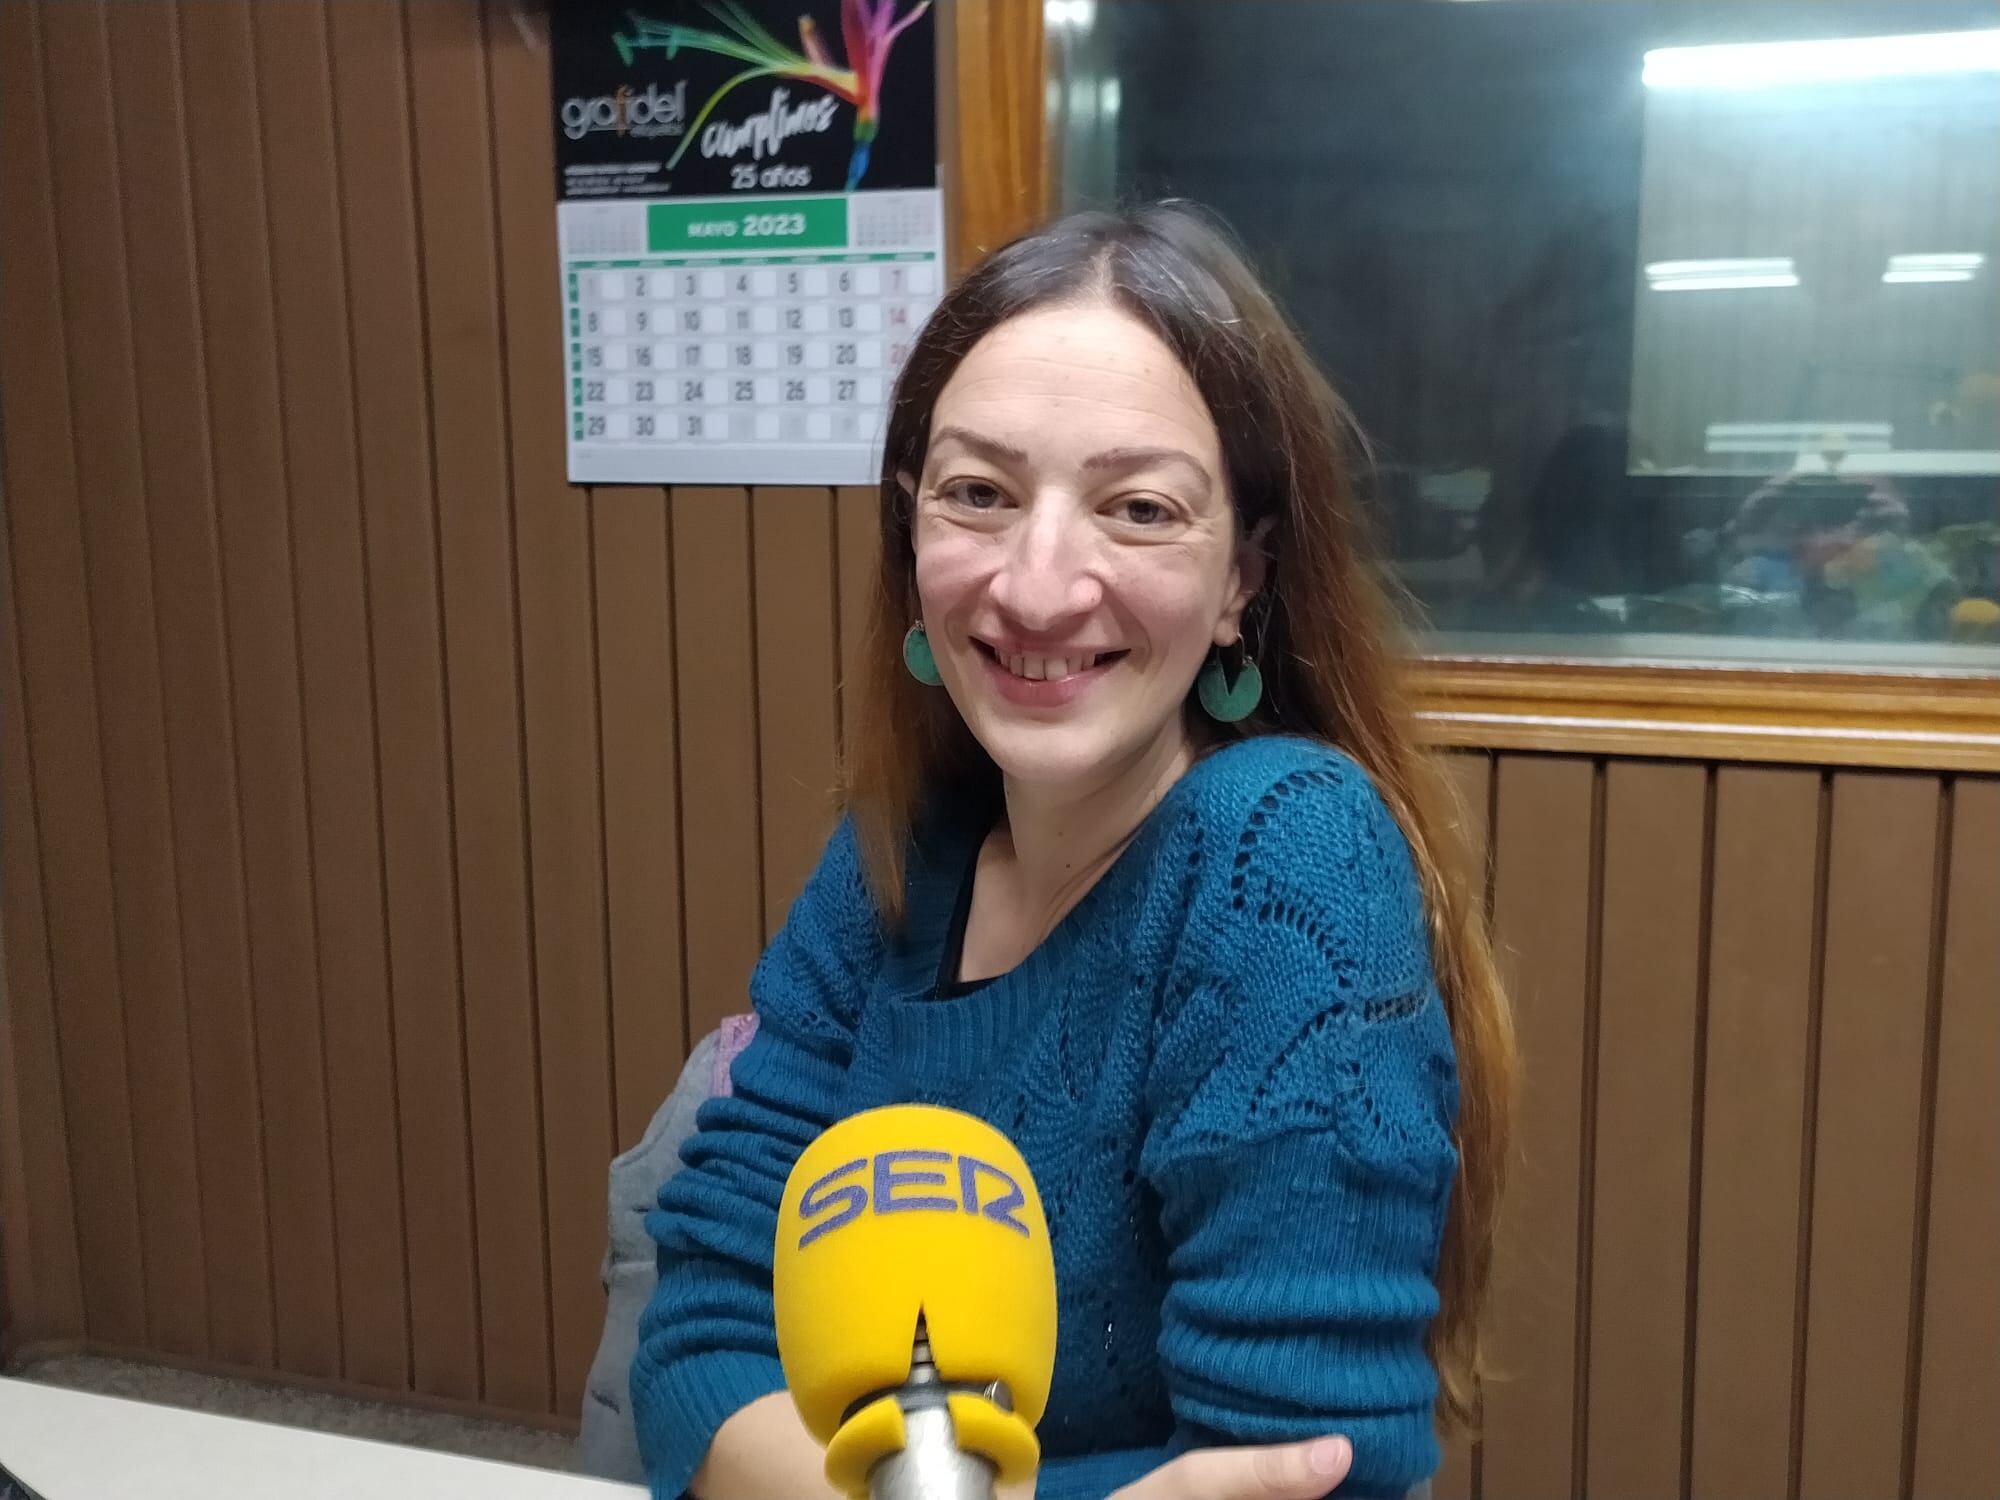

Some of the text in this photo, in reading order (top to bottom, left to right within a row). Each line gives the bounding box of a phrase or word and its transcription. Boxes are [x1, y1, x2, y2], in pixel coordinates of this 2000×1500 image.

[730, 164, 758, 189] 25
[687, 212, 807, 238] MAYO 2023
[635, 275, 646, 297] 2
[685, 274, 697, 297] 3
[736, 273, 748, 293] 4
[787, 272, 799, 294] 5
[838, 271, 851, 293] 6
[587, 311, 598, 333] 8
[636, 310, 648, 332] 9
[684, 309, 700, 332] 10
[786, 308, 802, 330] 12
[838, 307, 854, 329] 13
[587, 345, 603, 368] 15
[635, 345, 652, 368] 16
[685, 344, 701, 367] 17
[786, 344, 803, 366] 19
[836, 343, 857, 365] 20
[586, 379, 857, 402] 22 23 24 25 26 27
[588, 415, 703, 437] 29 30 31
[799, 1150, 1030, 1250] SER
